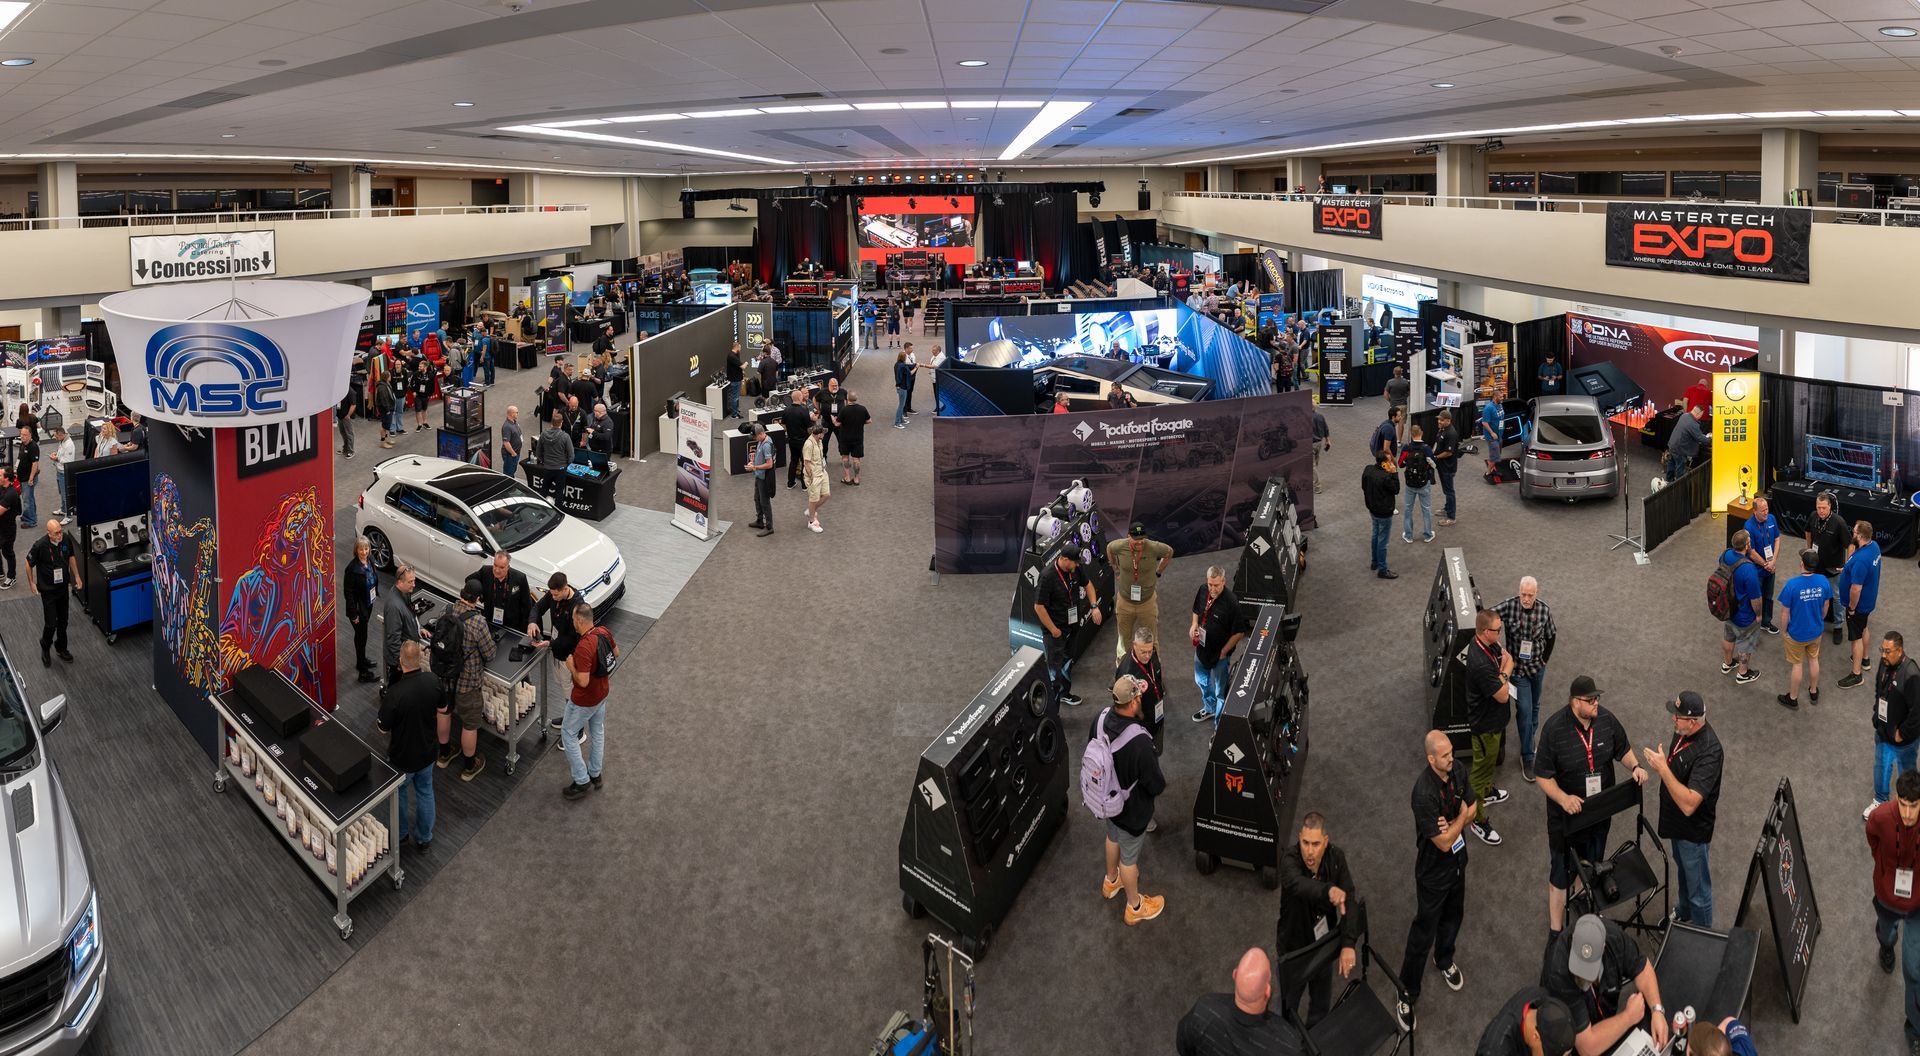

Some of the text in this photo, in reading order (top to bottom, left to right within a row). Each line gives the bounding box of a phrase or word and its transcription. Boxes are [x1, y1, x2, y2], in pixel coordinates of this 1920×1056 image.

[1322, 208, 1370, 228] EXPO
[1634, 224, 1773, 264] EXPO
[151, 256, 260, 280] Concessions
[1657, 258, 1711, 268] PROFESSIONALS
[1269, 262, 1285, 289] KICKER
[640, 310, 670, 319] audison
[1447, 314, 1480, 332] SiriusXM
[1592, 324, 1630, 340] DNA
[1610, 338, 1632, 347] REFERENCE
[1682, 348, 1716, 364] ARC
[150, 377, 286, 416] MSC
[680, 408, 696, 418] ESCORT
[681, 415, 698, 426] REDLINE
[1100, 418, 1194, 439] Rockford Fosgate
[245, 416, 311, 466] BLAM
[1196, 822, 1274, 843] ROCKFORDFOSGATE.COM
[1210, 820, 1230, 828] PURPOSE
[902, 864, 971, 913] ROCKFORDFOSGATE.COM
[914, 866, 957, 896] PURPOSE BUILT AUDIO
